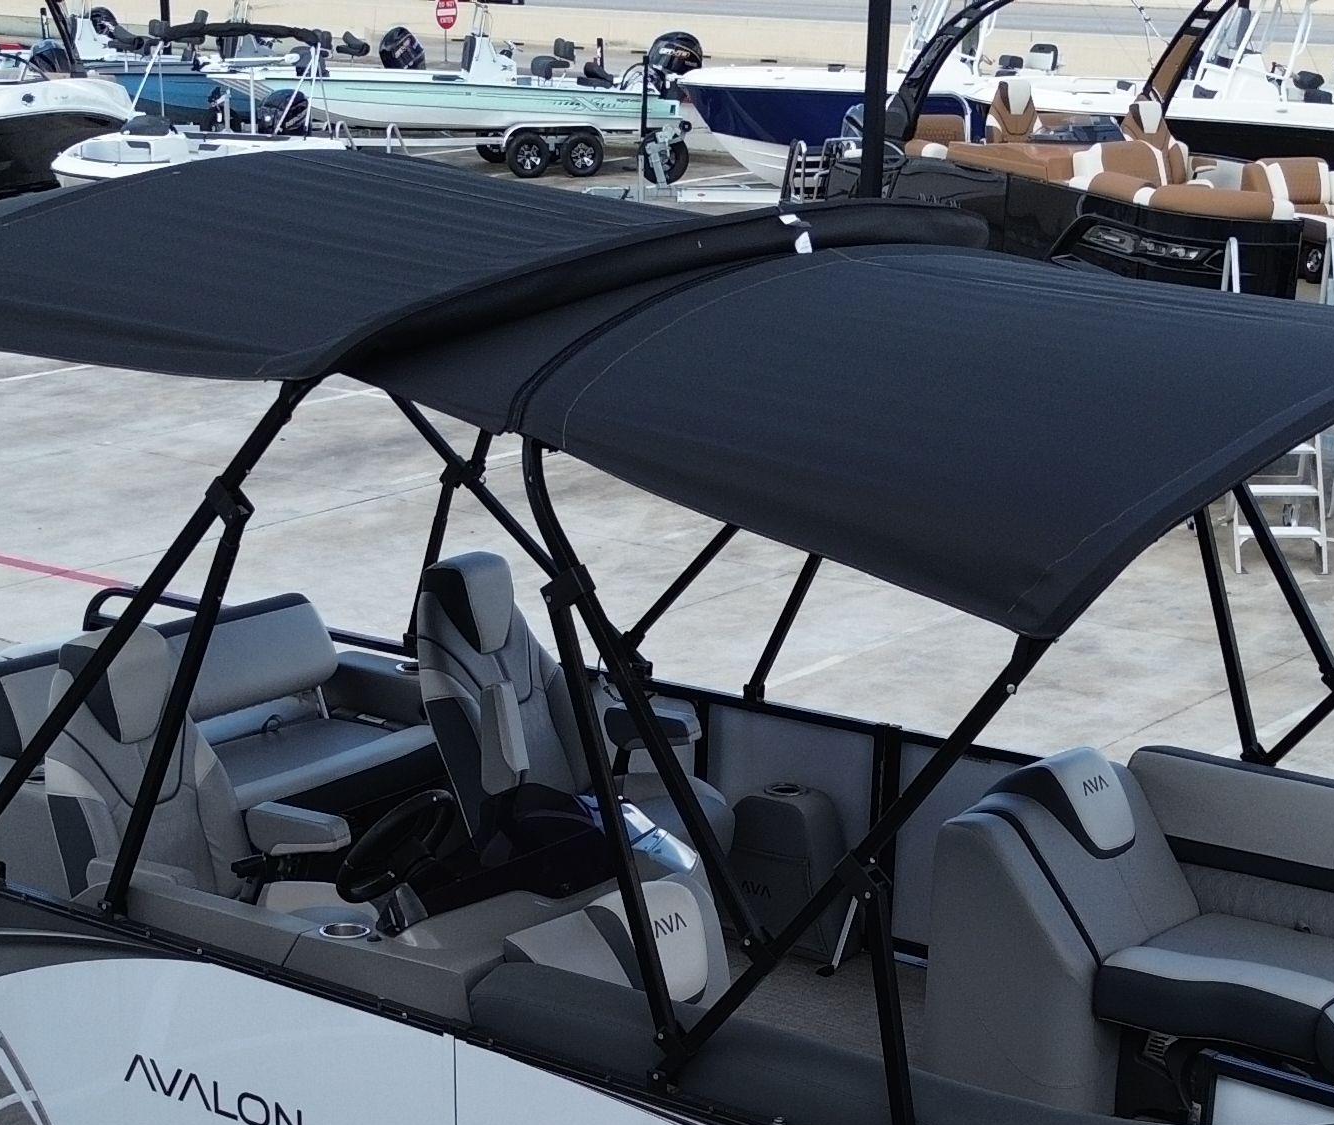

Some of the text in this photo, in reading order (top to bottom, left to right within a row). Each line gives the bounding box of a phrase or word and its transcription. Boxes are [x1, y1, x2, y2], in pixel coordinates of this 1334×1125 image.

[1082, 774, 1110, 797] AVA
[741, 880, 772, 899] AVA
[653, 912, 687, 939] AVA
